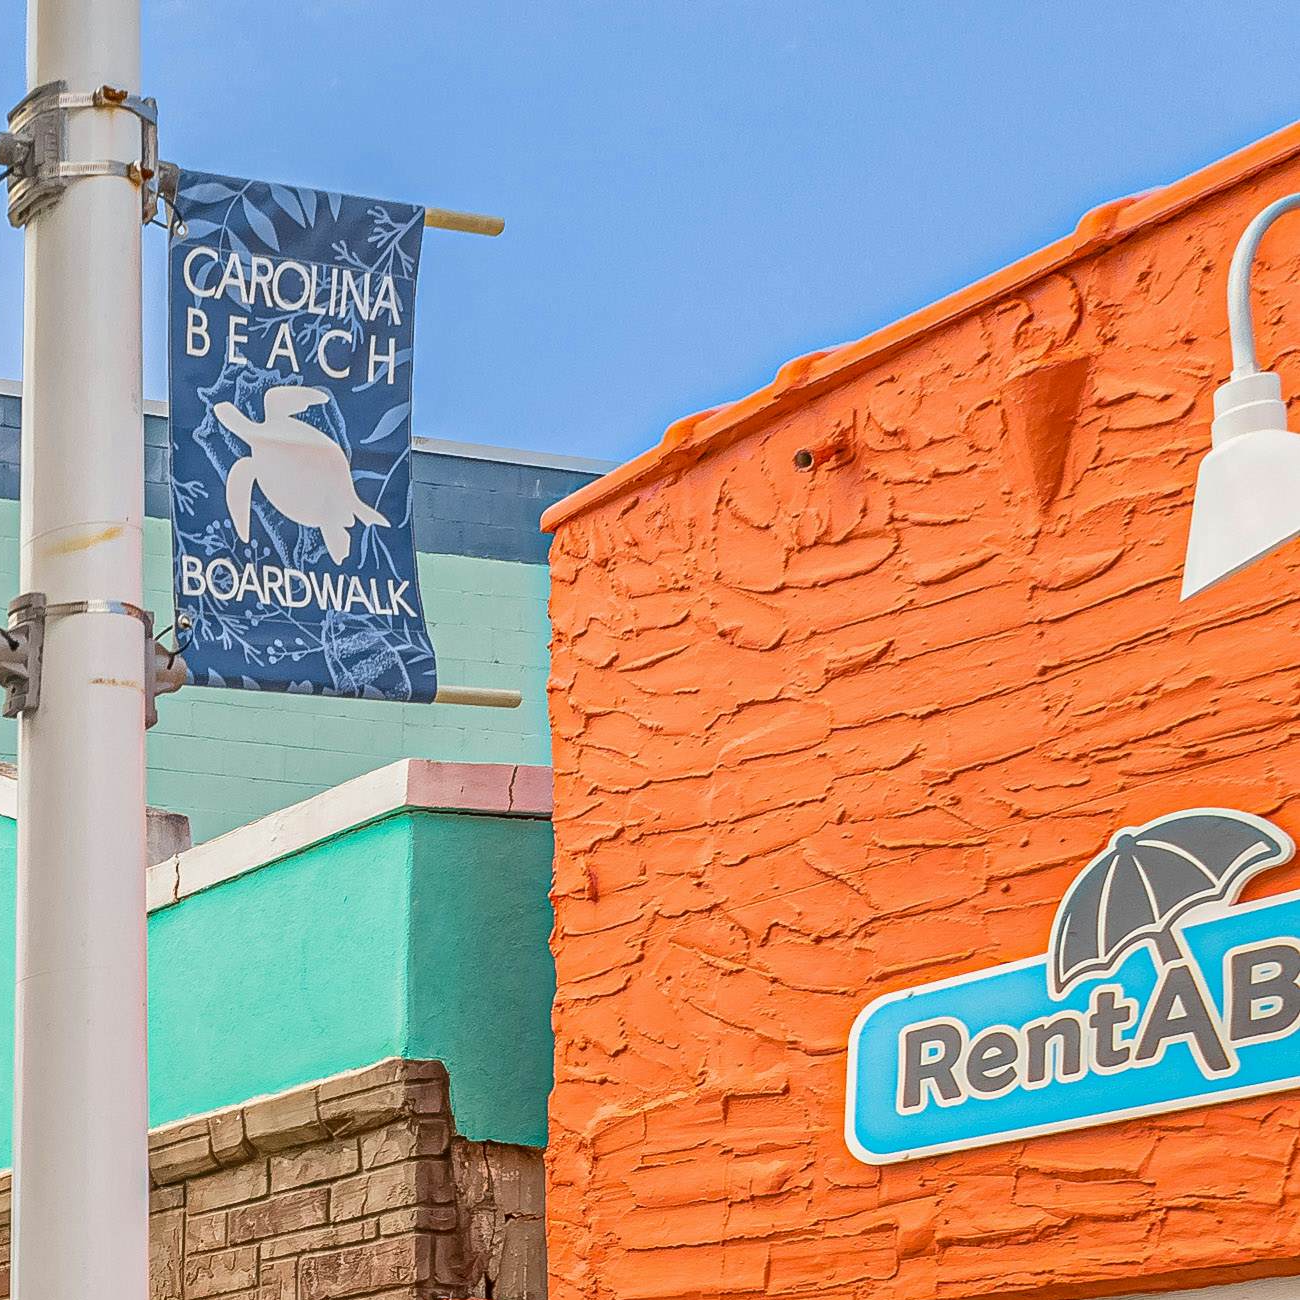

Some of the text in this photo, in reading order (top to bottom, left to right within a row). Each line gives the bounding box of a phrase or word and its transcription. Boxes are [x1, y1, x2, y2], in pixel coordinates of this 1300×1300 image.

[184, 246, 401, 325] CAROLINA
[186, 307, 396, 384] BEACH
[182, 555, 418, 618] BOARDWALK
